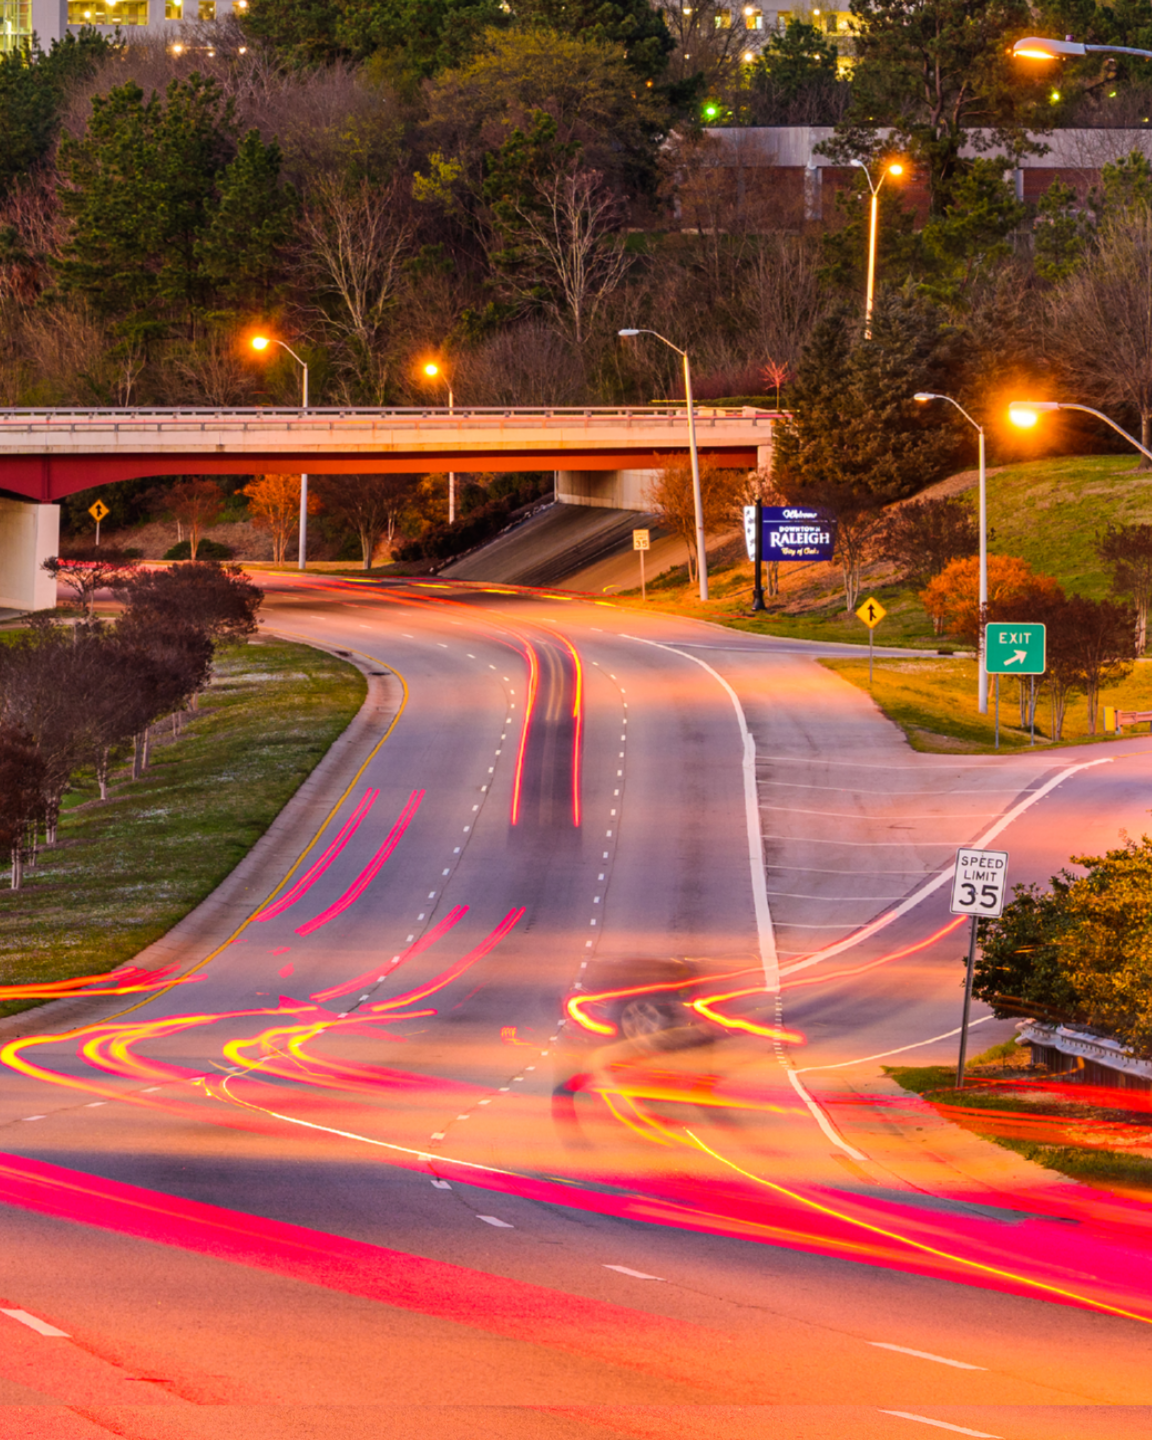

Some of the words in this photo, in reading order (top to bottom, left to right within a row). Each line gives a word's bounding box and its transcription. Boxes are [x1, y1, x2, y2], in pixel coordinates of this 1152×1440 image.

[779, 525, 821, 533] DOWNTOWN
[770, 531, 830, 547] RALEIGH
[999, 632, 1032, 644] EXIT
[961, 856, 1004, 869] SPEED
[964, 870, 997, 882] LIMIT
[959, 883, 999, 908] 35
